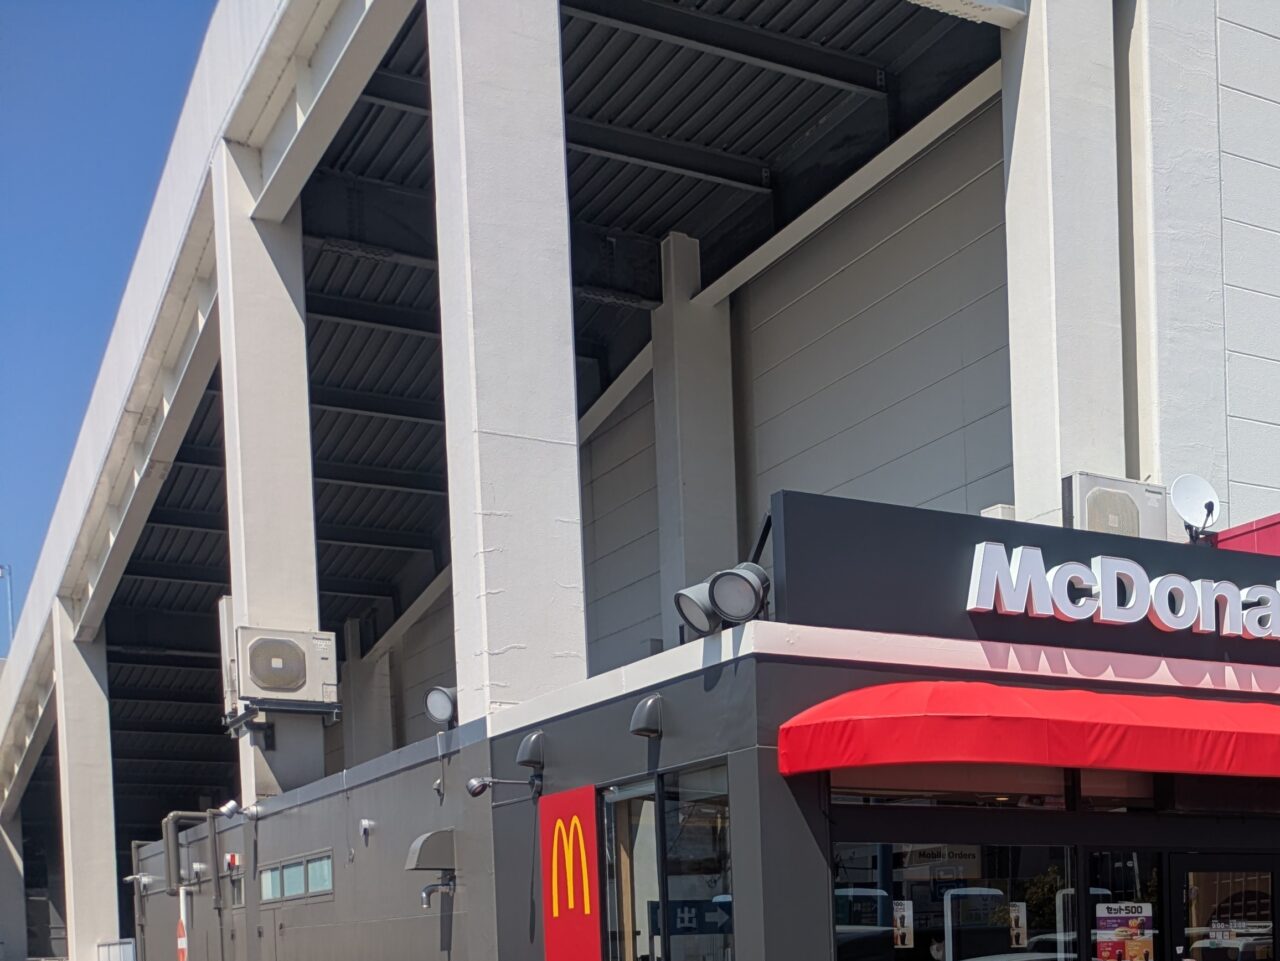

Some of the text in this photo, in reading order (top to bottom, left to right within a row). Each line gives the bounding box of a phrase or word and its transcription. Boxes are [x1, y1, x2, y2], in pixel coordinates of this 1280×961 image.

[948, 851, 976, 859] Orders
[1106, 905, 1142, 914] セット500
